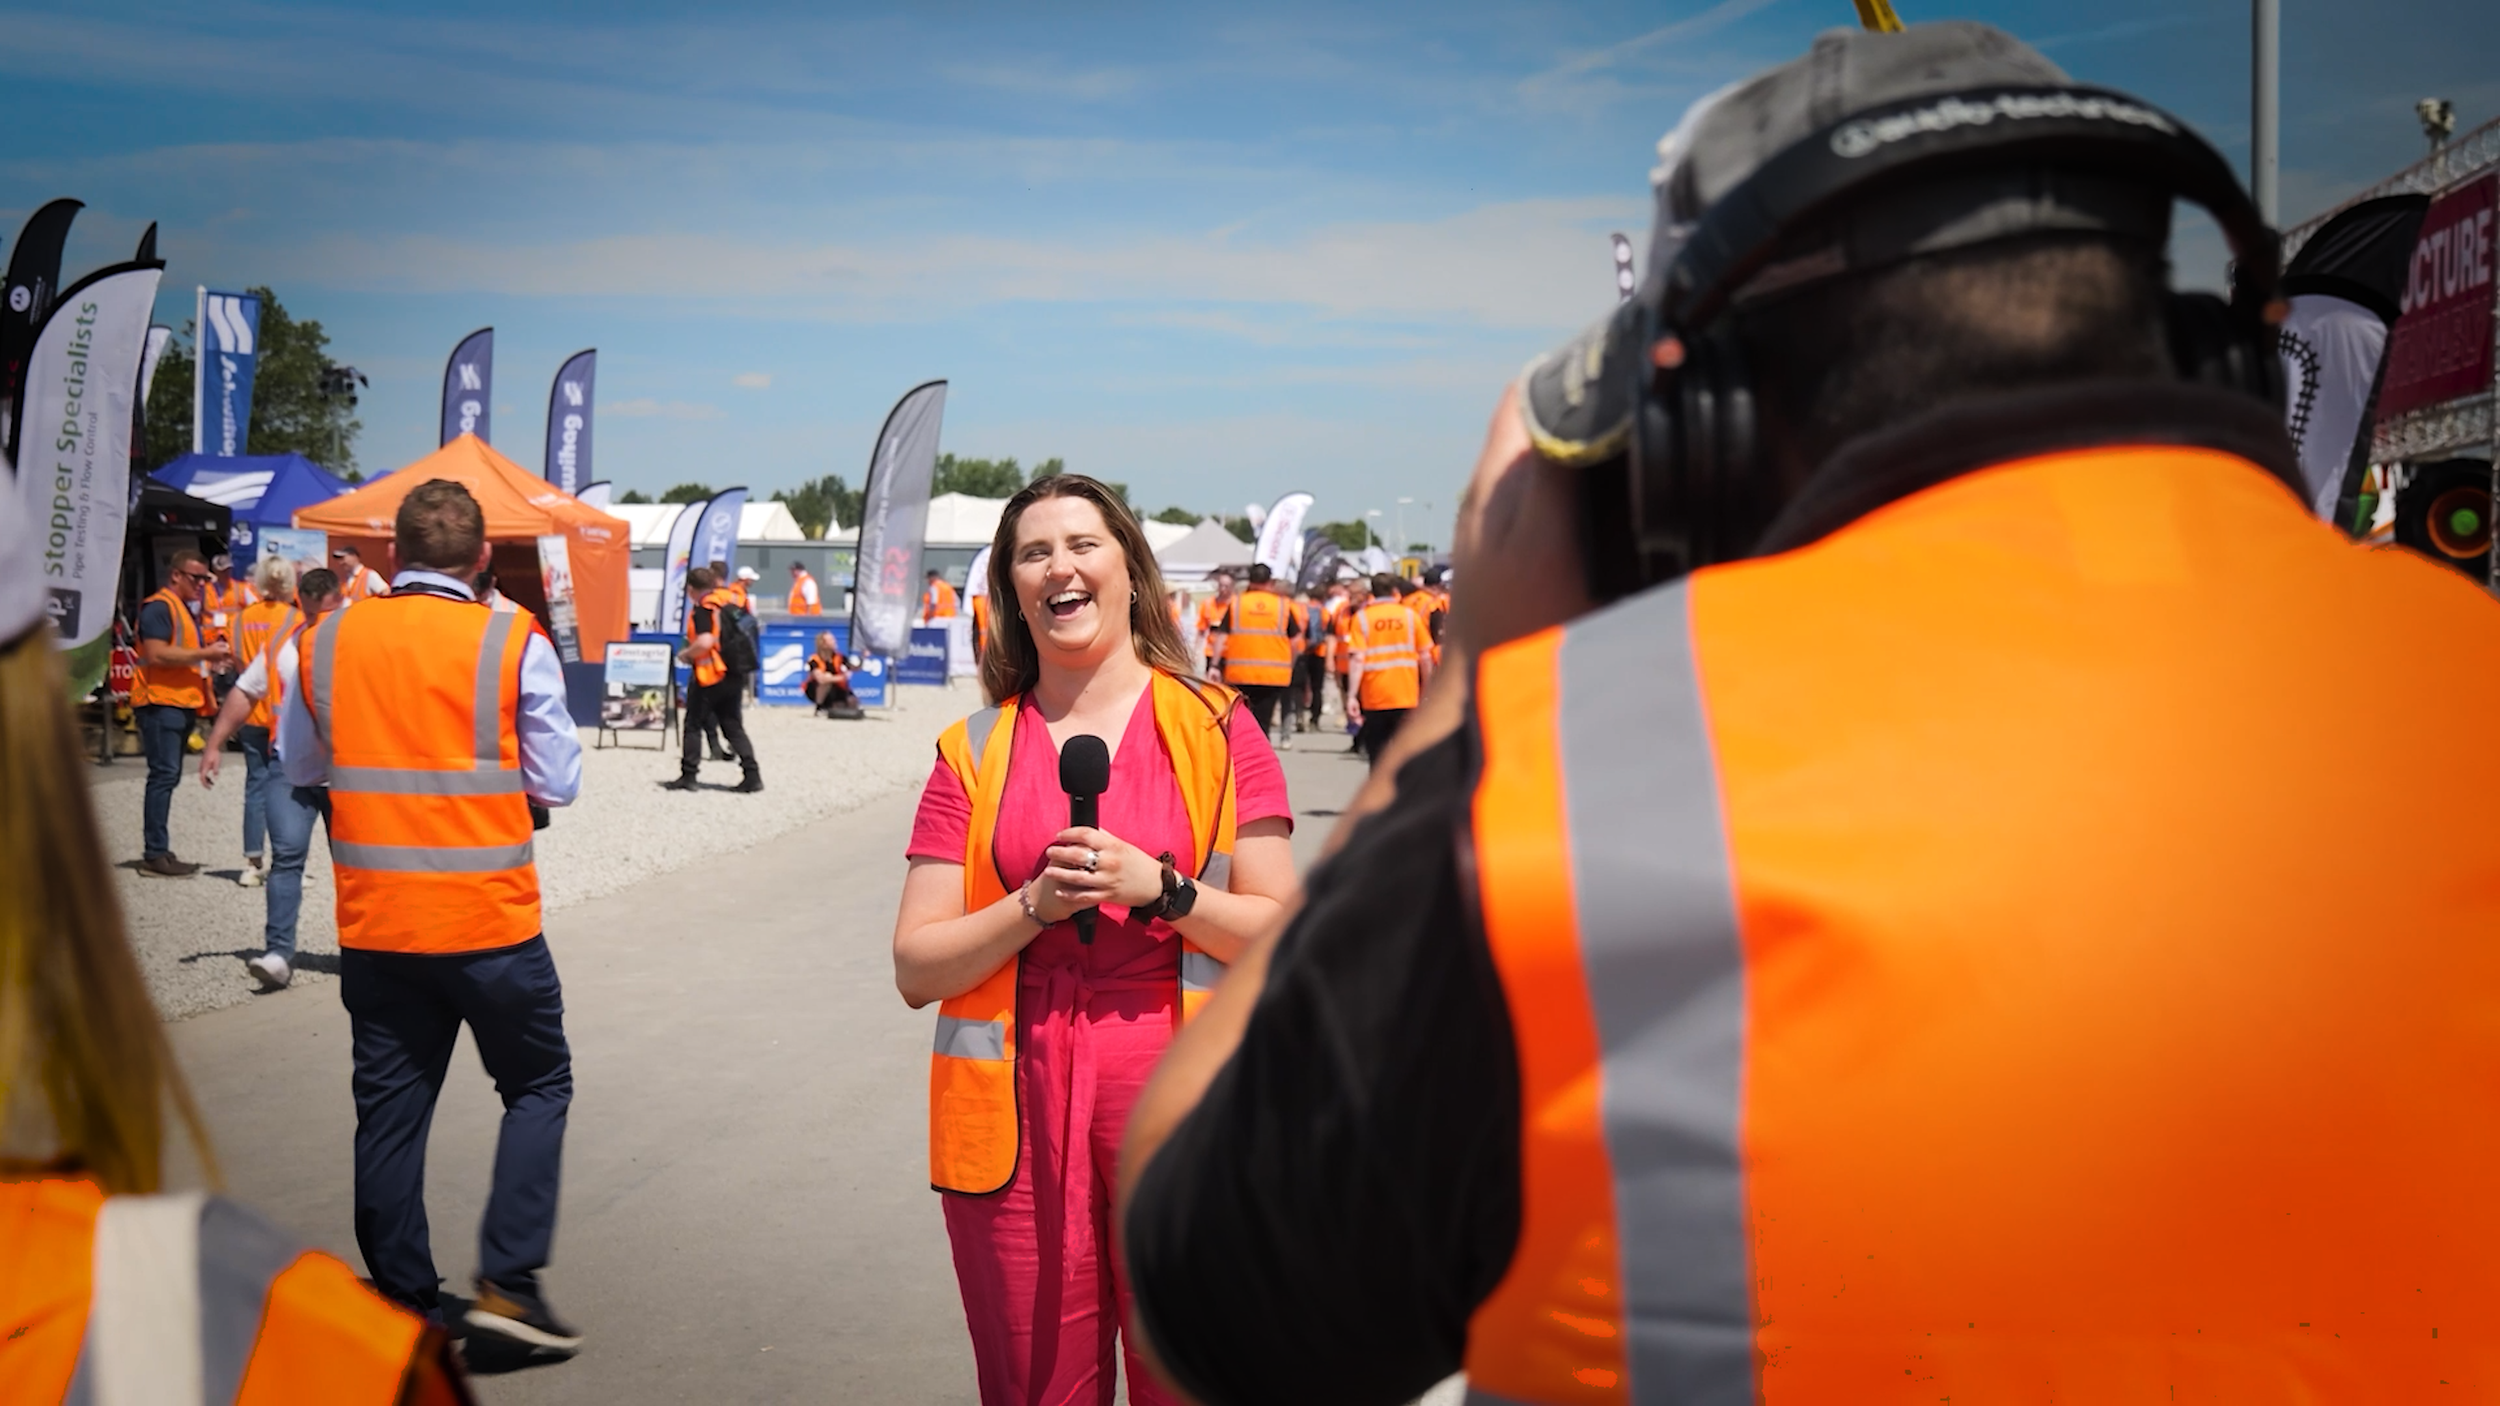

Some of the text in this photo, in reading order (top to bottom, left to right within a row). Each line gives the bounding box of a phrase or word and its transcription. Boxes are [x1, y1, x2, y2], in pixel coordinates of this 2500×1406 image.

[44, 301, 98, 577] Stopper Specialists
[72, 411, 98, 579] Pipe Testing & Flow Control
[1374, 618, 1404, 632] OTS
[110, 664, 133, 680] STO
